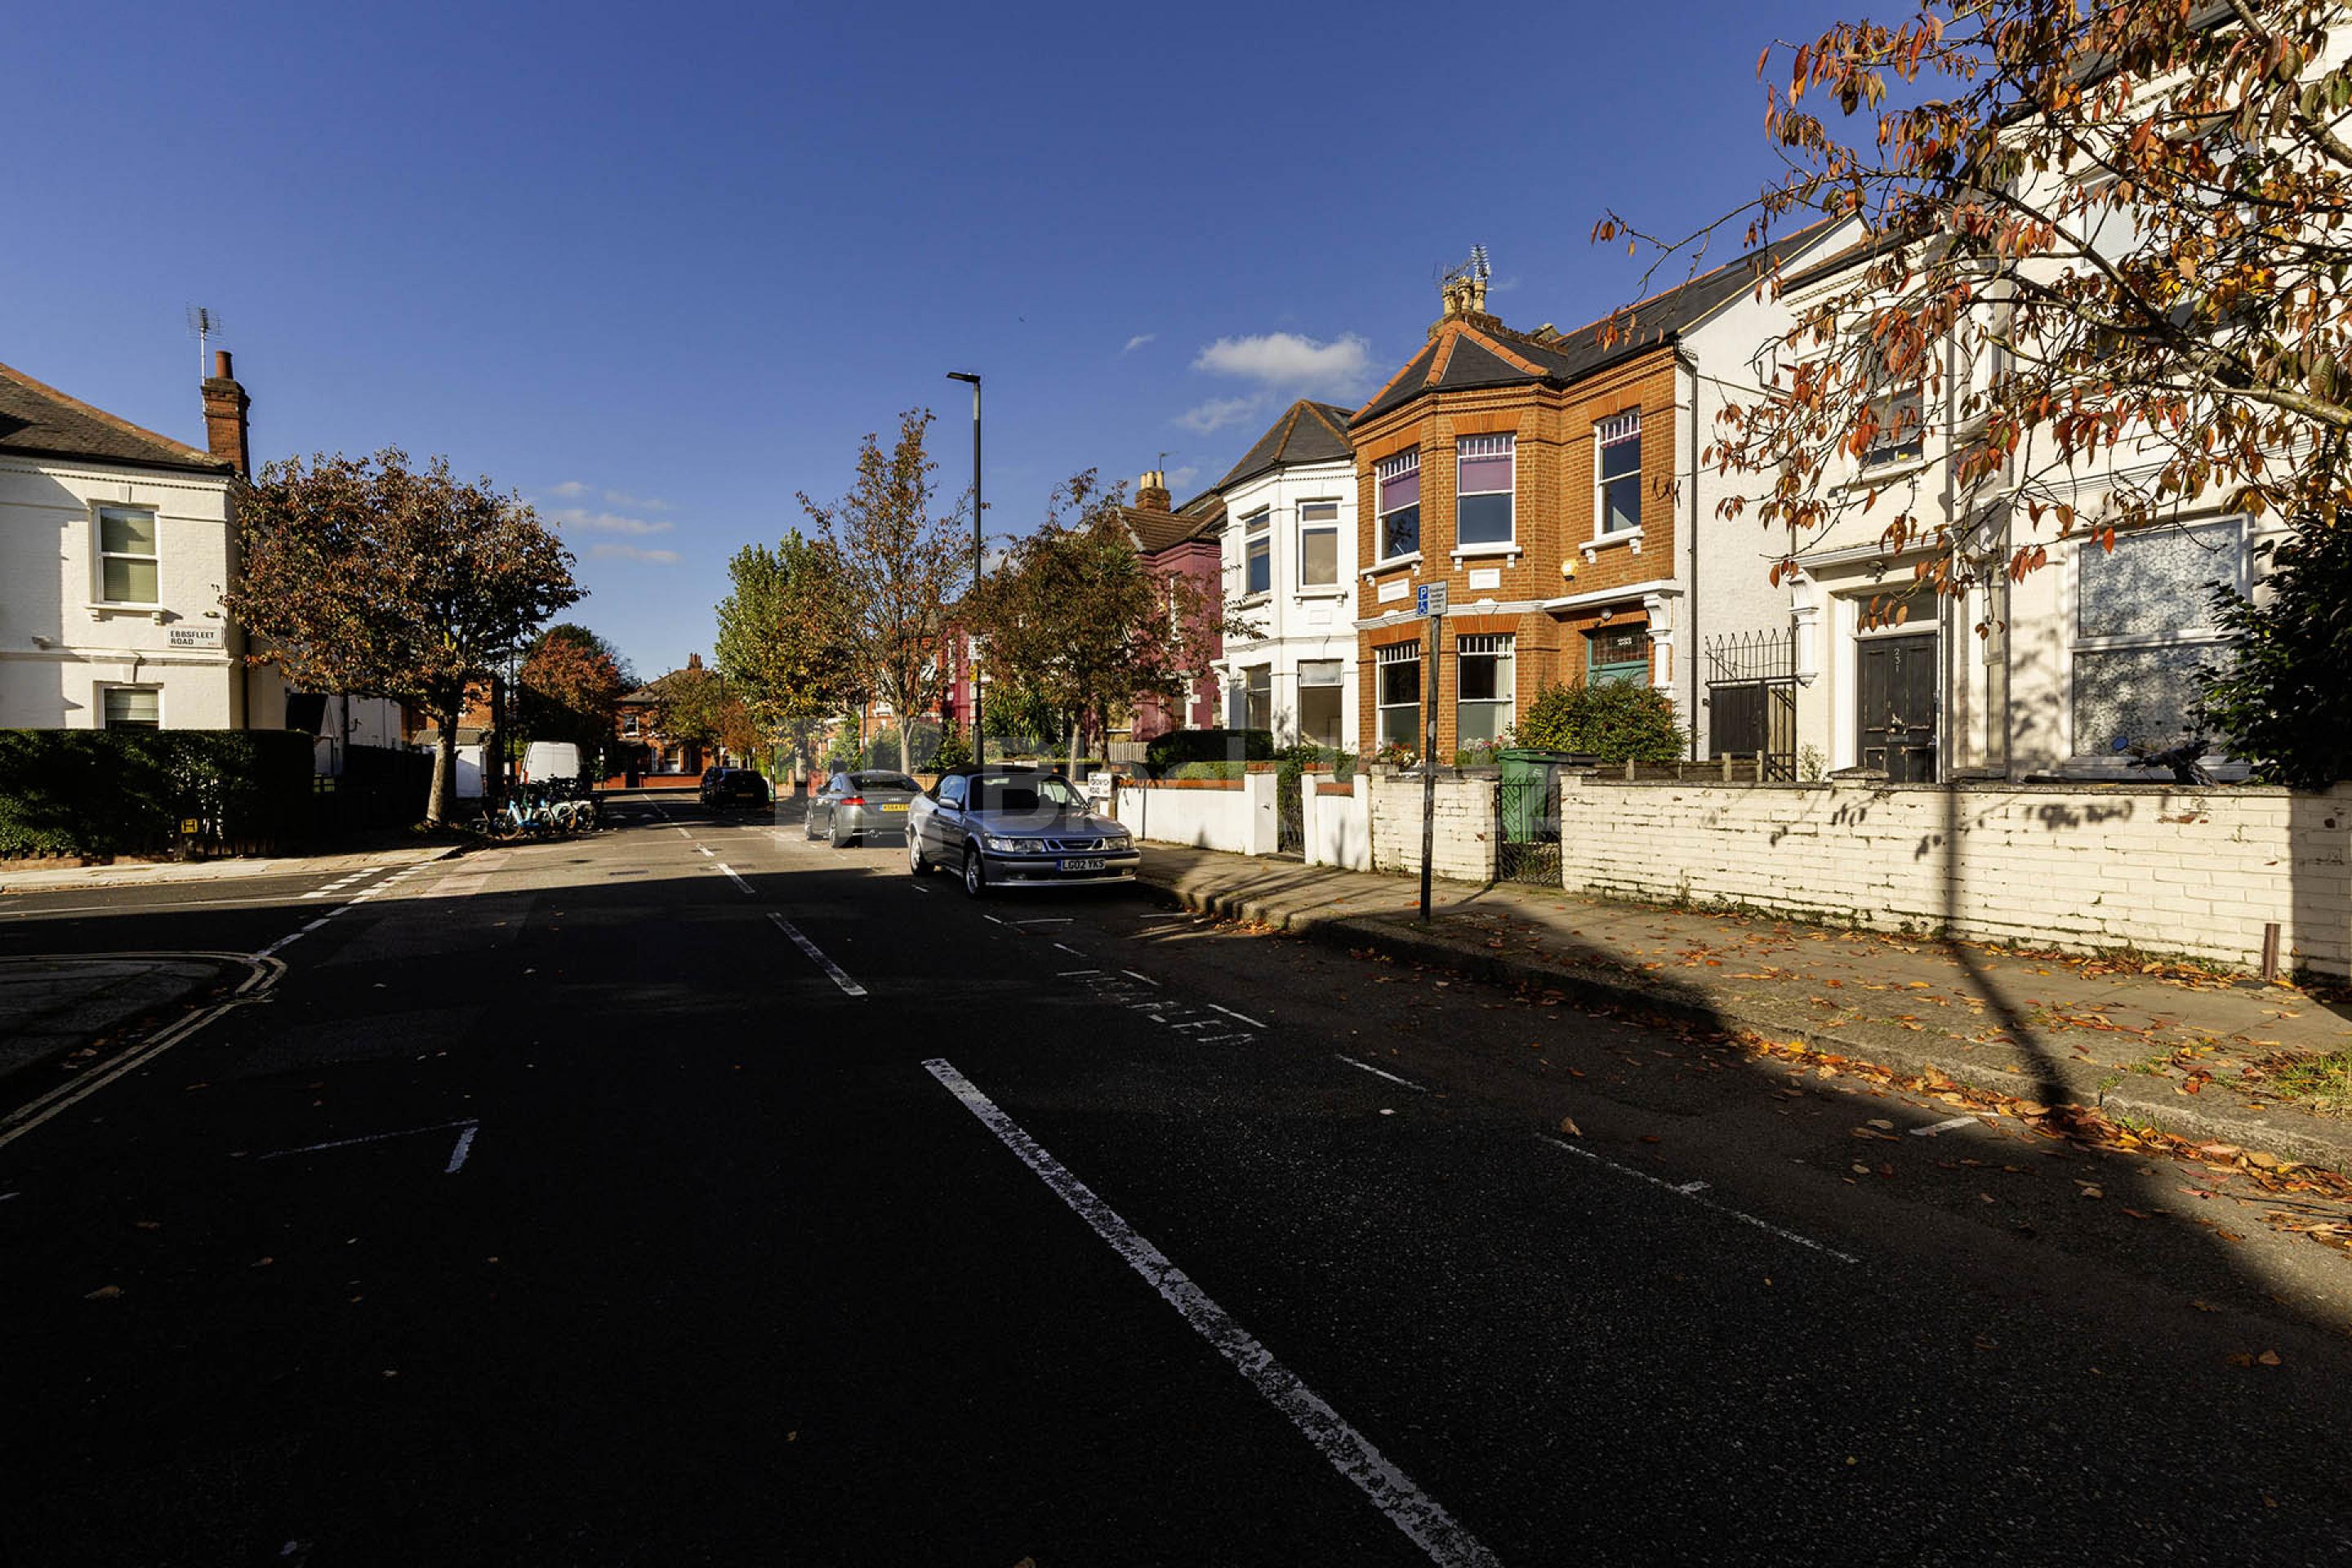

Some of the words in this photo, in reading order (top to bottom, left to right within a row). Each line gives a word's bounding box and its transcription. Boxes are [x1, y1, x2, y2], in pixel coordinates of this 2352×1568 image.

[1421, 588, 1427, 598] P
[170, 630, 214, 639] EBBSFLEET
[184, 820, 196, 831] H
[1063, 860, 1086, 870] LG02
[1088, 859, 1104, 868] YKS
